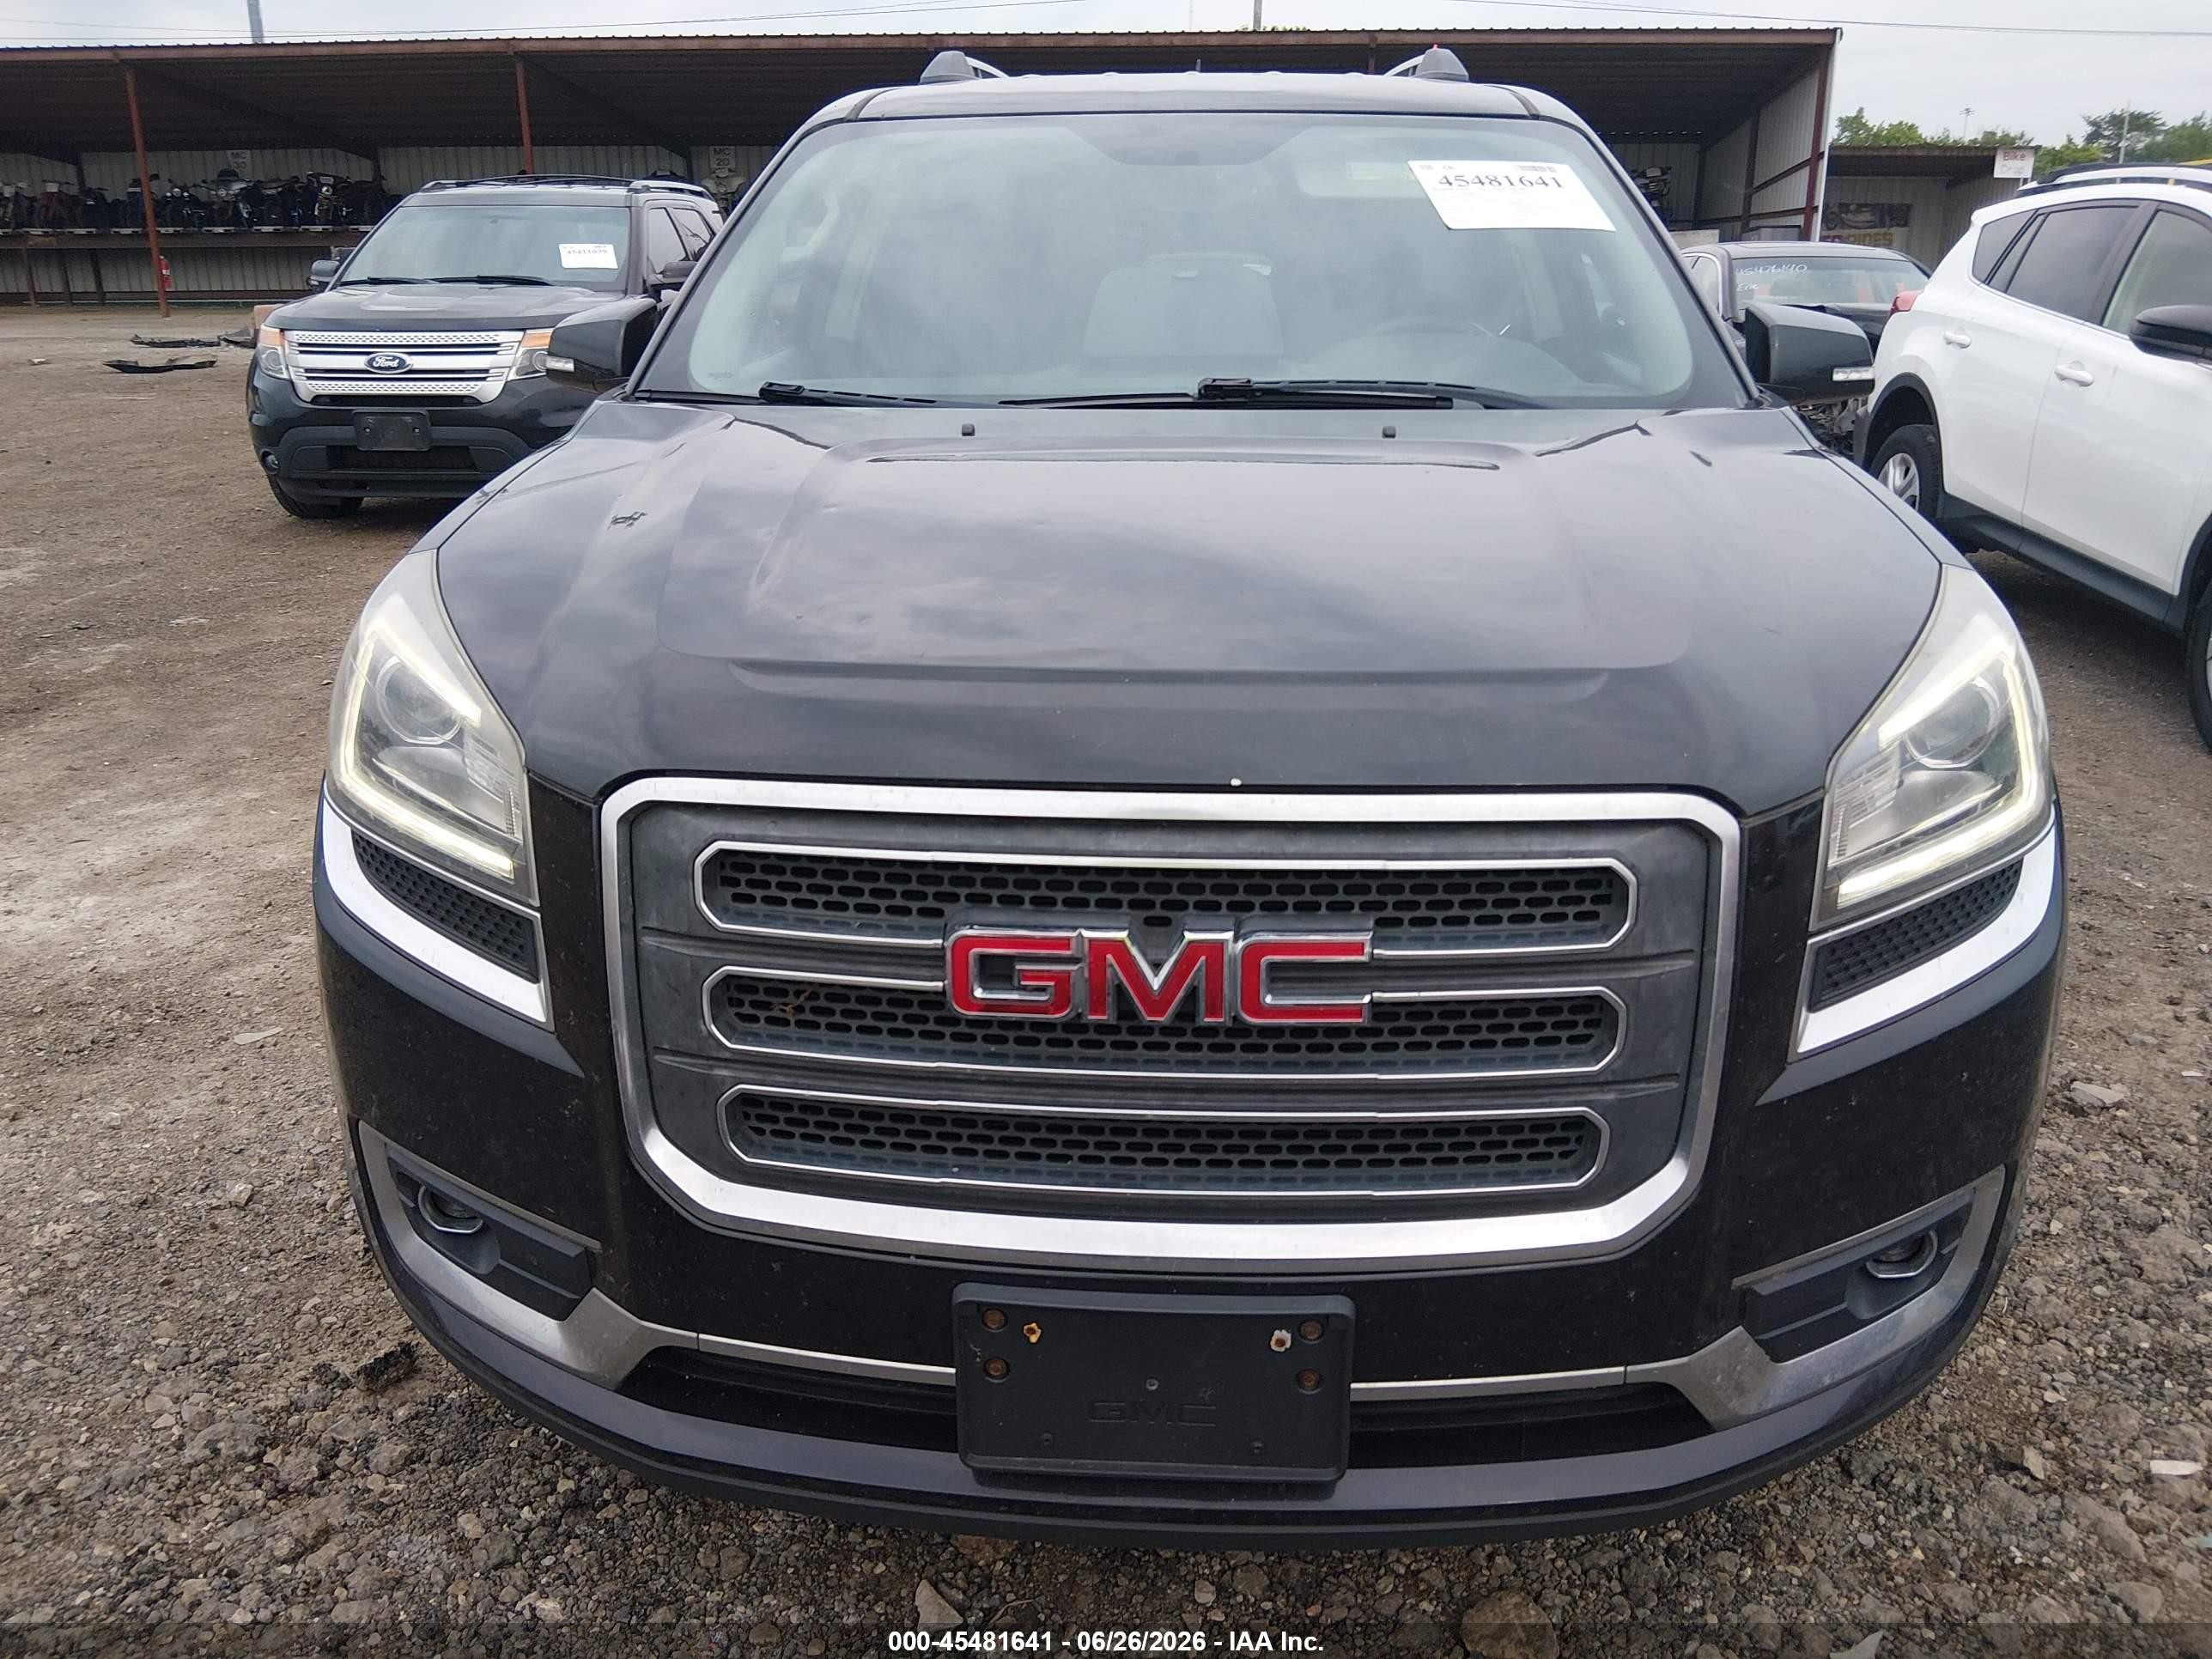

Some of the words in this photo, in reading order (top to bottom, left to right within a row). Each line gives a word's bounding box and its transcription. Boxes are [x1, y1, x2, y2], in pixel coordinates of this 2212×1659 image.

[2003, 151, 2027, 161] Bike
[1438, 174, 1565, 189] 45481641
[373, 356, 400, 368] Ford
[945, 926, 1373, 1025] GMC
[1087, 1401, 1217, 1427] GMC
